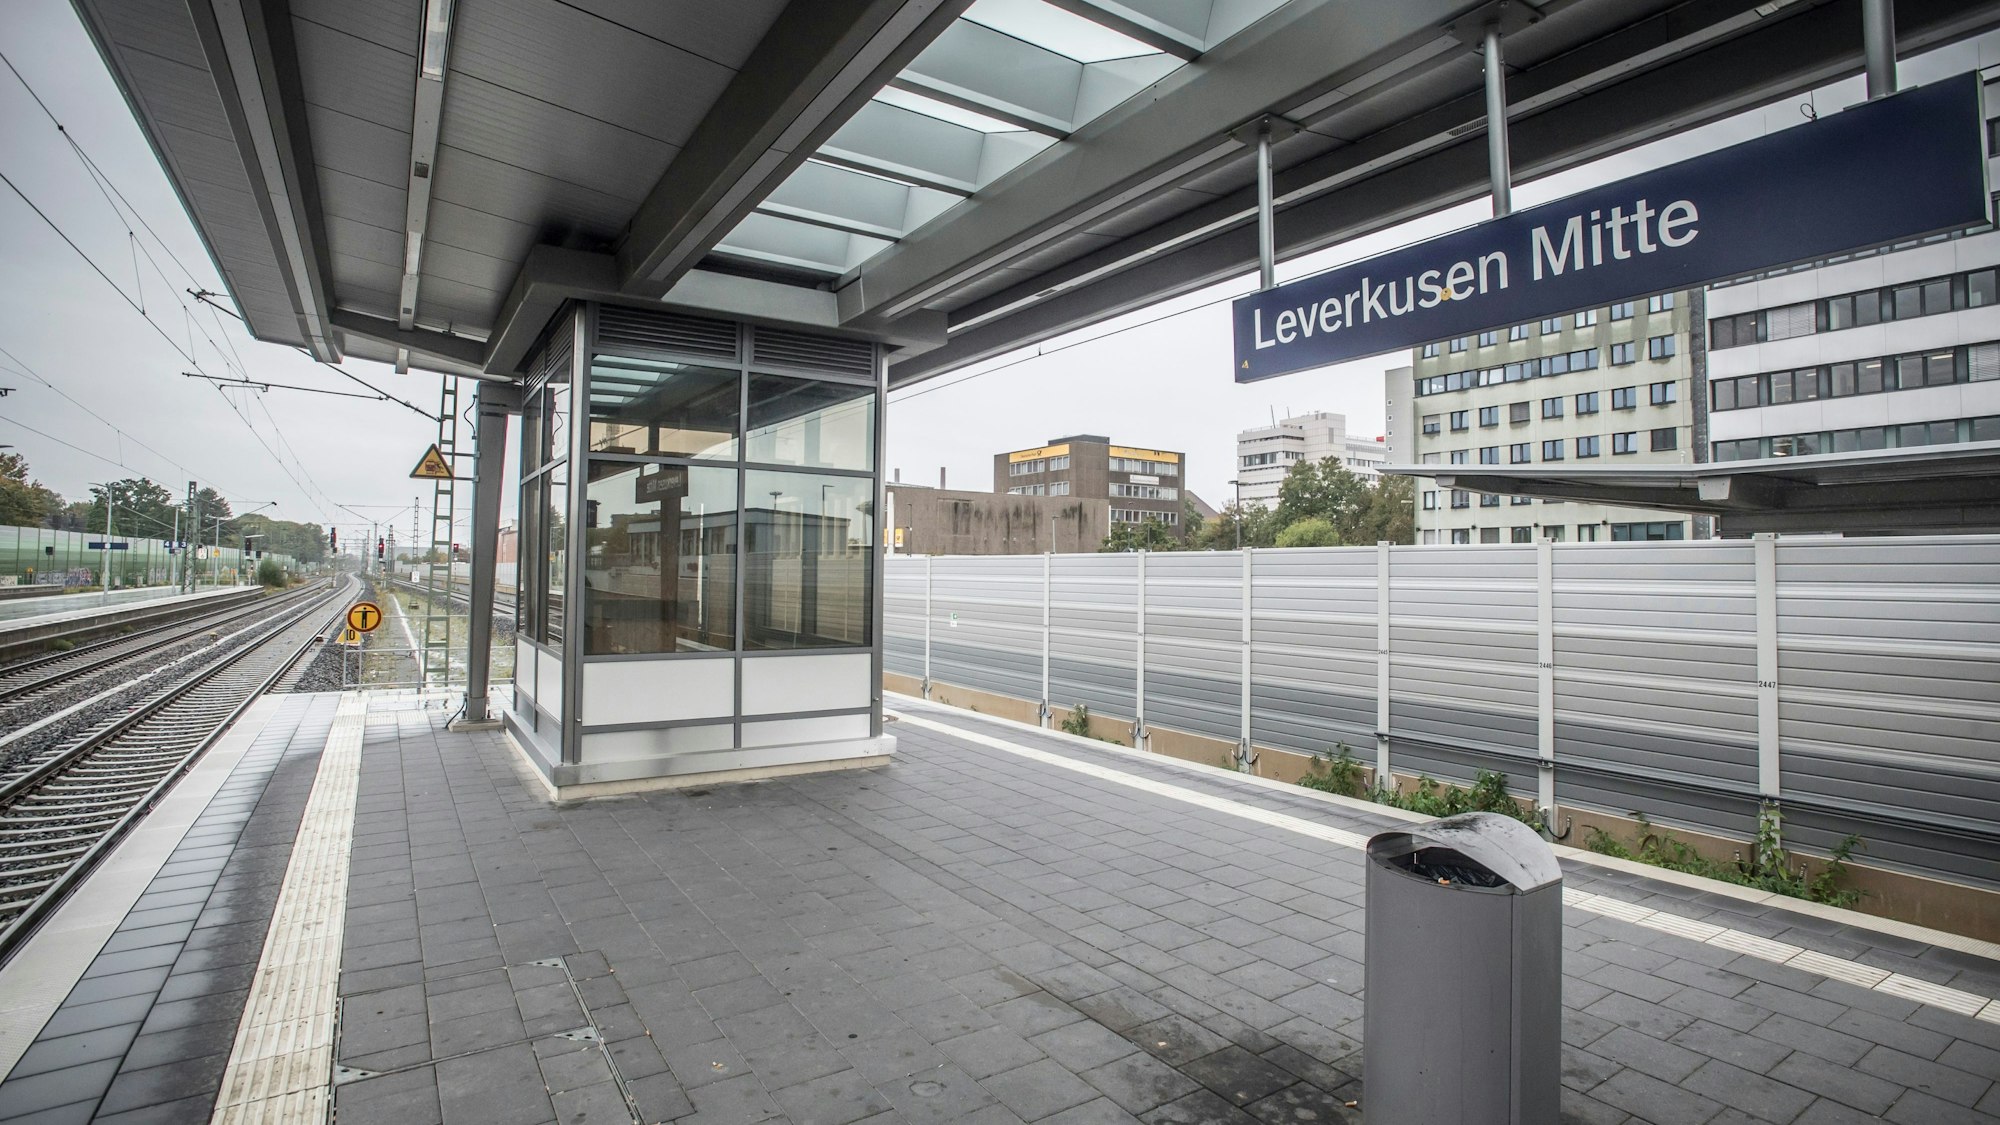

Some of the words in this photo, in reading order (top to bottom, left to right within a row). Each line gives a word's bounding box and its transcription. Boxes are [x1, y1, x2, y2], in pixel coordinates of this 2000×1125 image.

[1254, 251, 1509, 350] Leverkusen
[1532, 199, 1699, 281] Mitte
[1758, 681, 1776, 689] 2447
